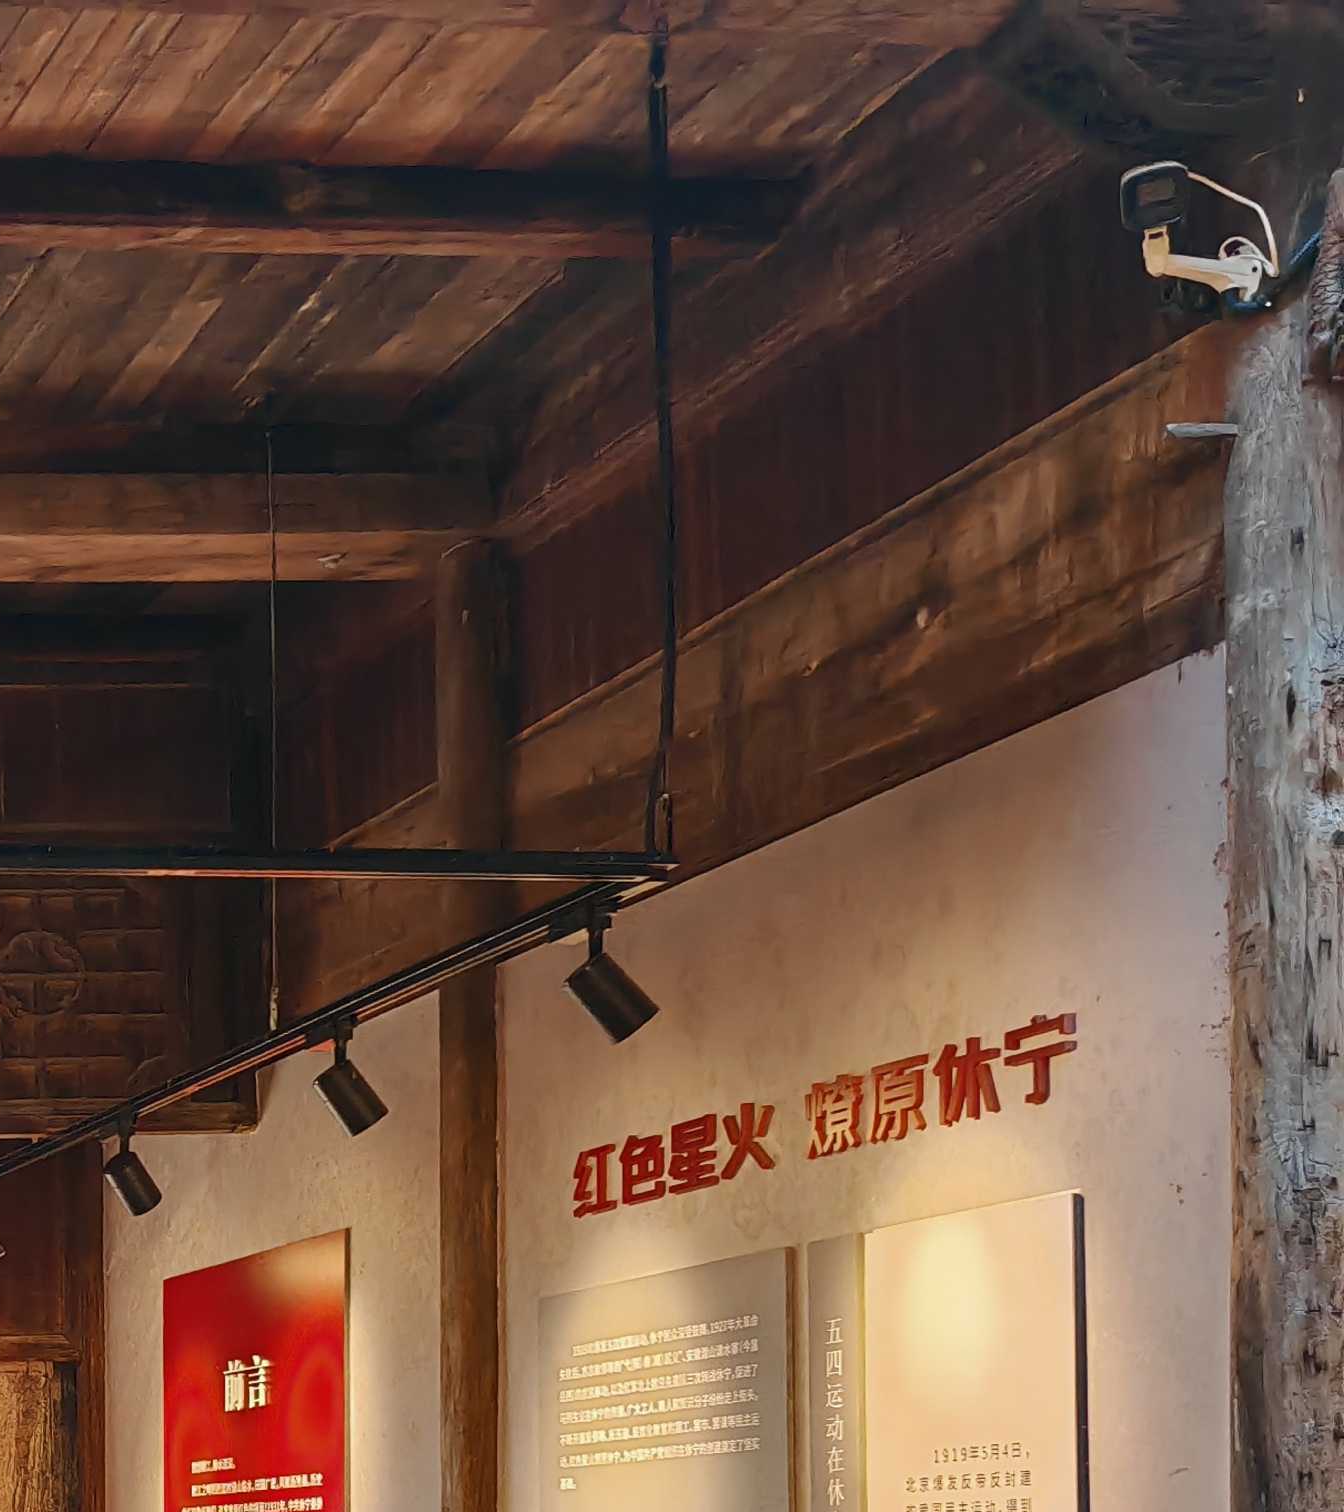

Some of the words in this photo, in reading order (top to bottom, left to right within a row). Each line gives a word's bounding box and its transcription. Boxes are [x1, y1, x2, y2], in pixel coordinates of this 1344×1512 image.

[572, 1103, 776, 1218] 红色星火
[804, 1013, 1078, 1159] 燎原休宁
